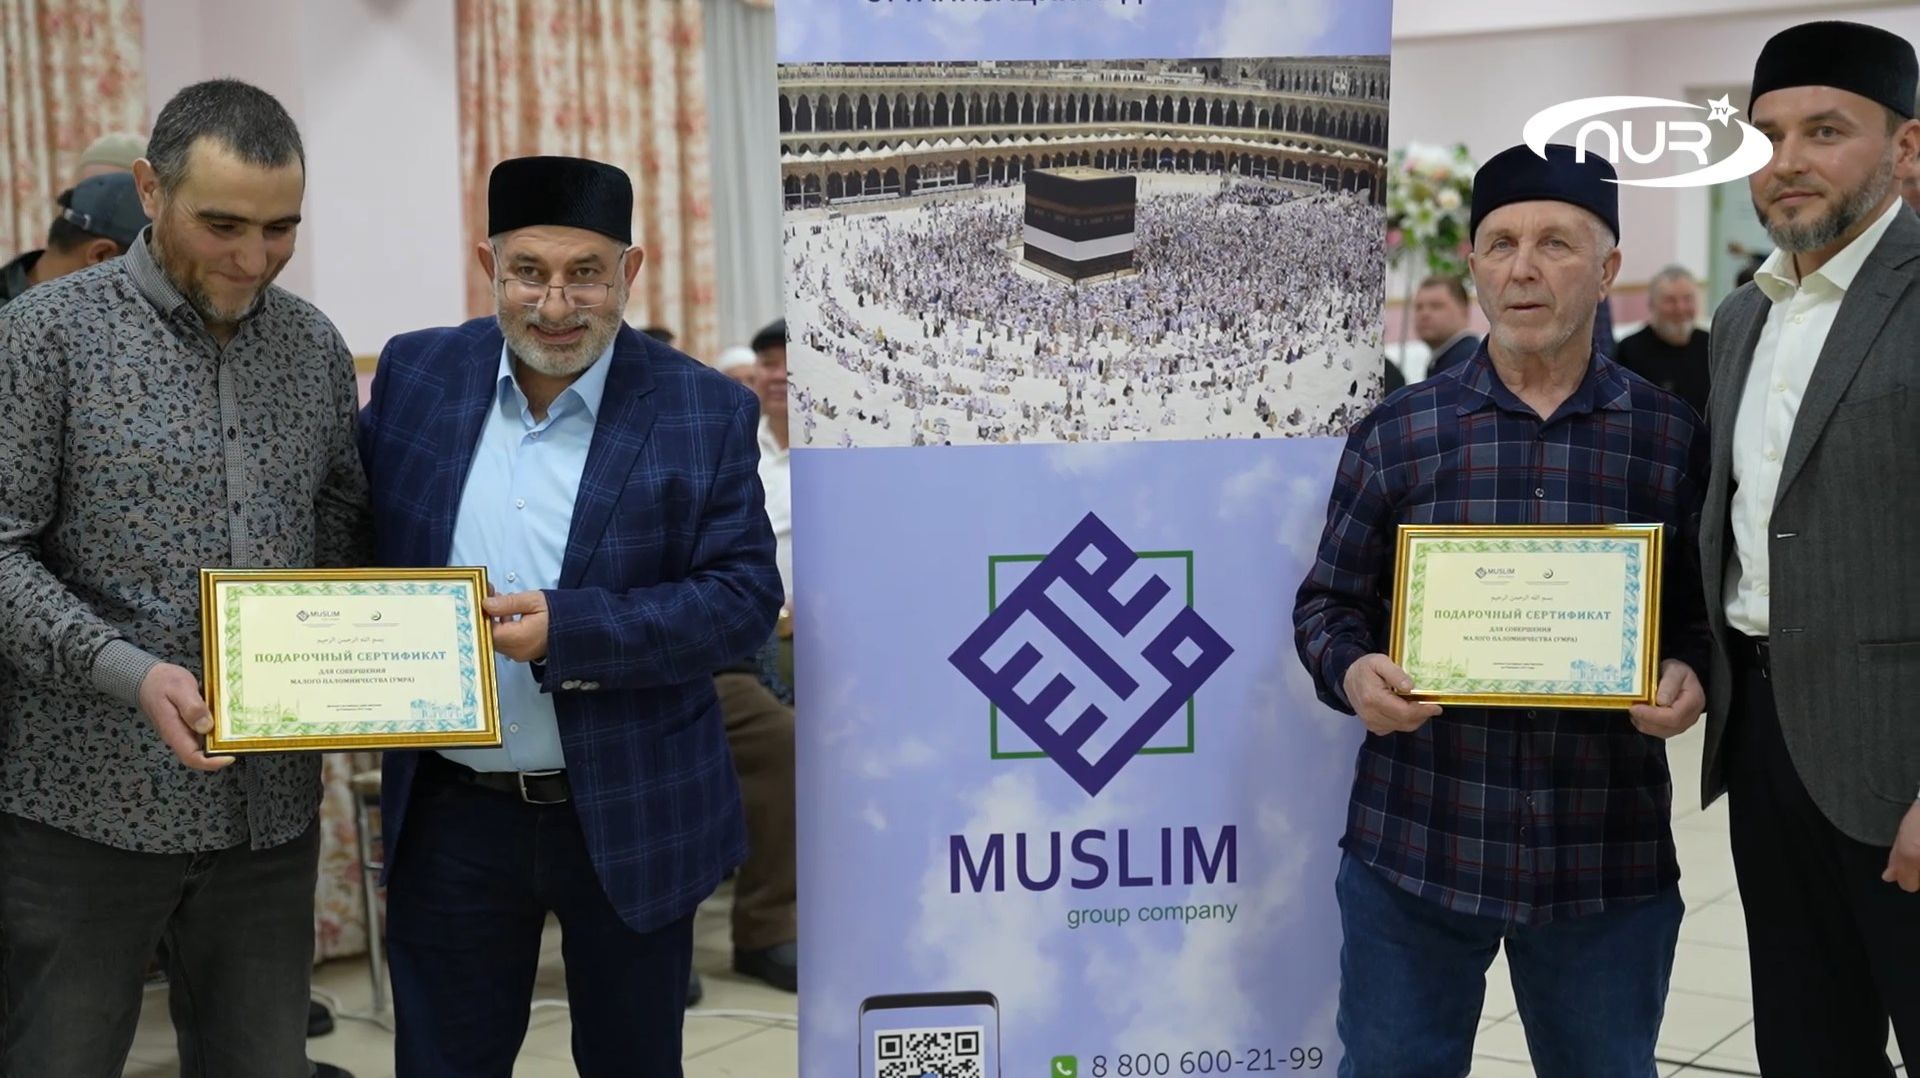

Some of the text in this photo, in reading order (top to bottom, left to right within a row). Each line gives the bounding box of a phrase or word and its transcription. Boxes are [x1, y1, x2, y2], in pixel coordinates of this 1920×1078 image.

[1434, 608, 1612, 621] ПОДАРОЧНЫЙ СЕРТИФИКАТ
[254, 650, 447, 664] ПОДАРОЧНЫЙ СЕРТИФИКАТ
[949, 825, 1238, 894] MUSLIM
[1067, 903, 1238, 930] group company
[1091, 1047, 1324, 1078] 8 800 600-21-99
